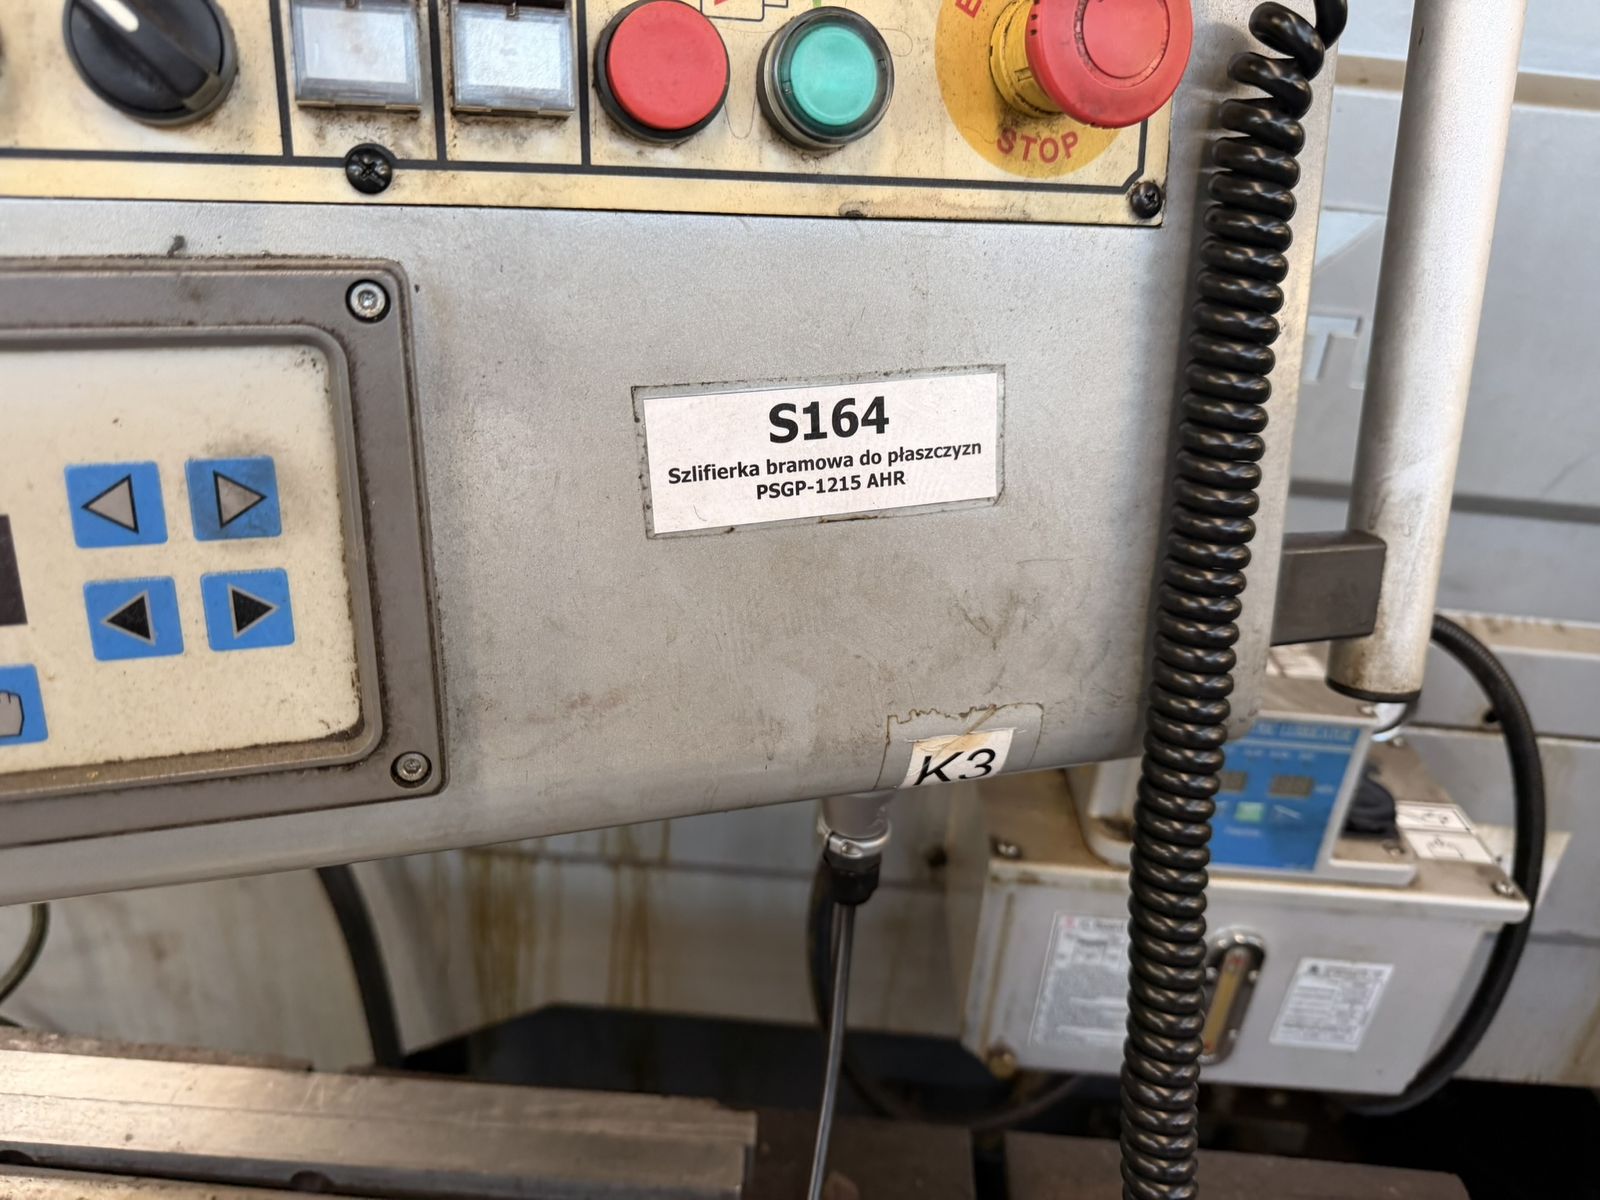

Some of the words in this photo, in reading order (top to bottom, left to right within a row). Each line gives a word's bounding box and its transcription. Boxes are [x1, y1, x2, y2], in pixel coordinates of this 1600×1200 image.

[996, 127, 1078, 163] STOP
[768, 396, 889, 444] S164
[668, 463, 760, 484] Szlifierka
[766, 454, 853, 475] bramowa
[860, 450, 881, 466] do
[887, 441, 982, 465] płaszczyzn
[757, 474, 861, 499] PSGP-1215
[867, 471, 905, 490] AHR
[912, 748, 996, 786] K3
